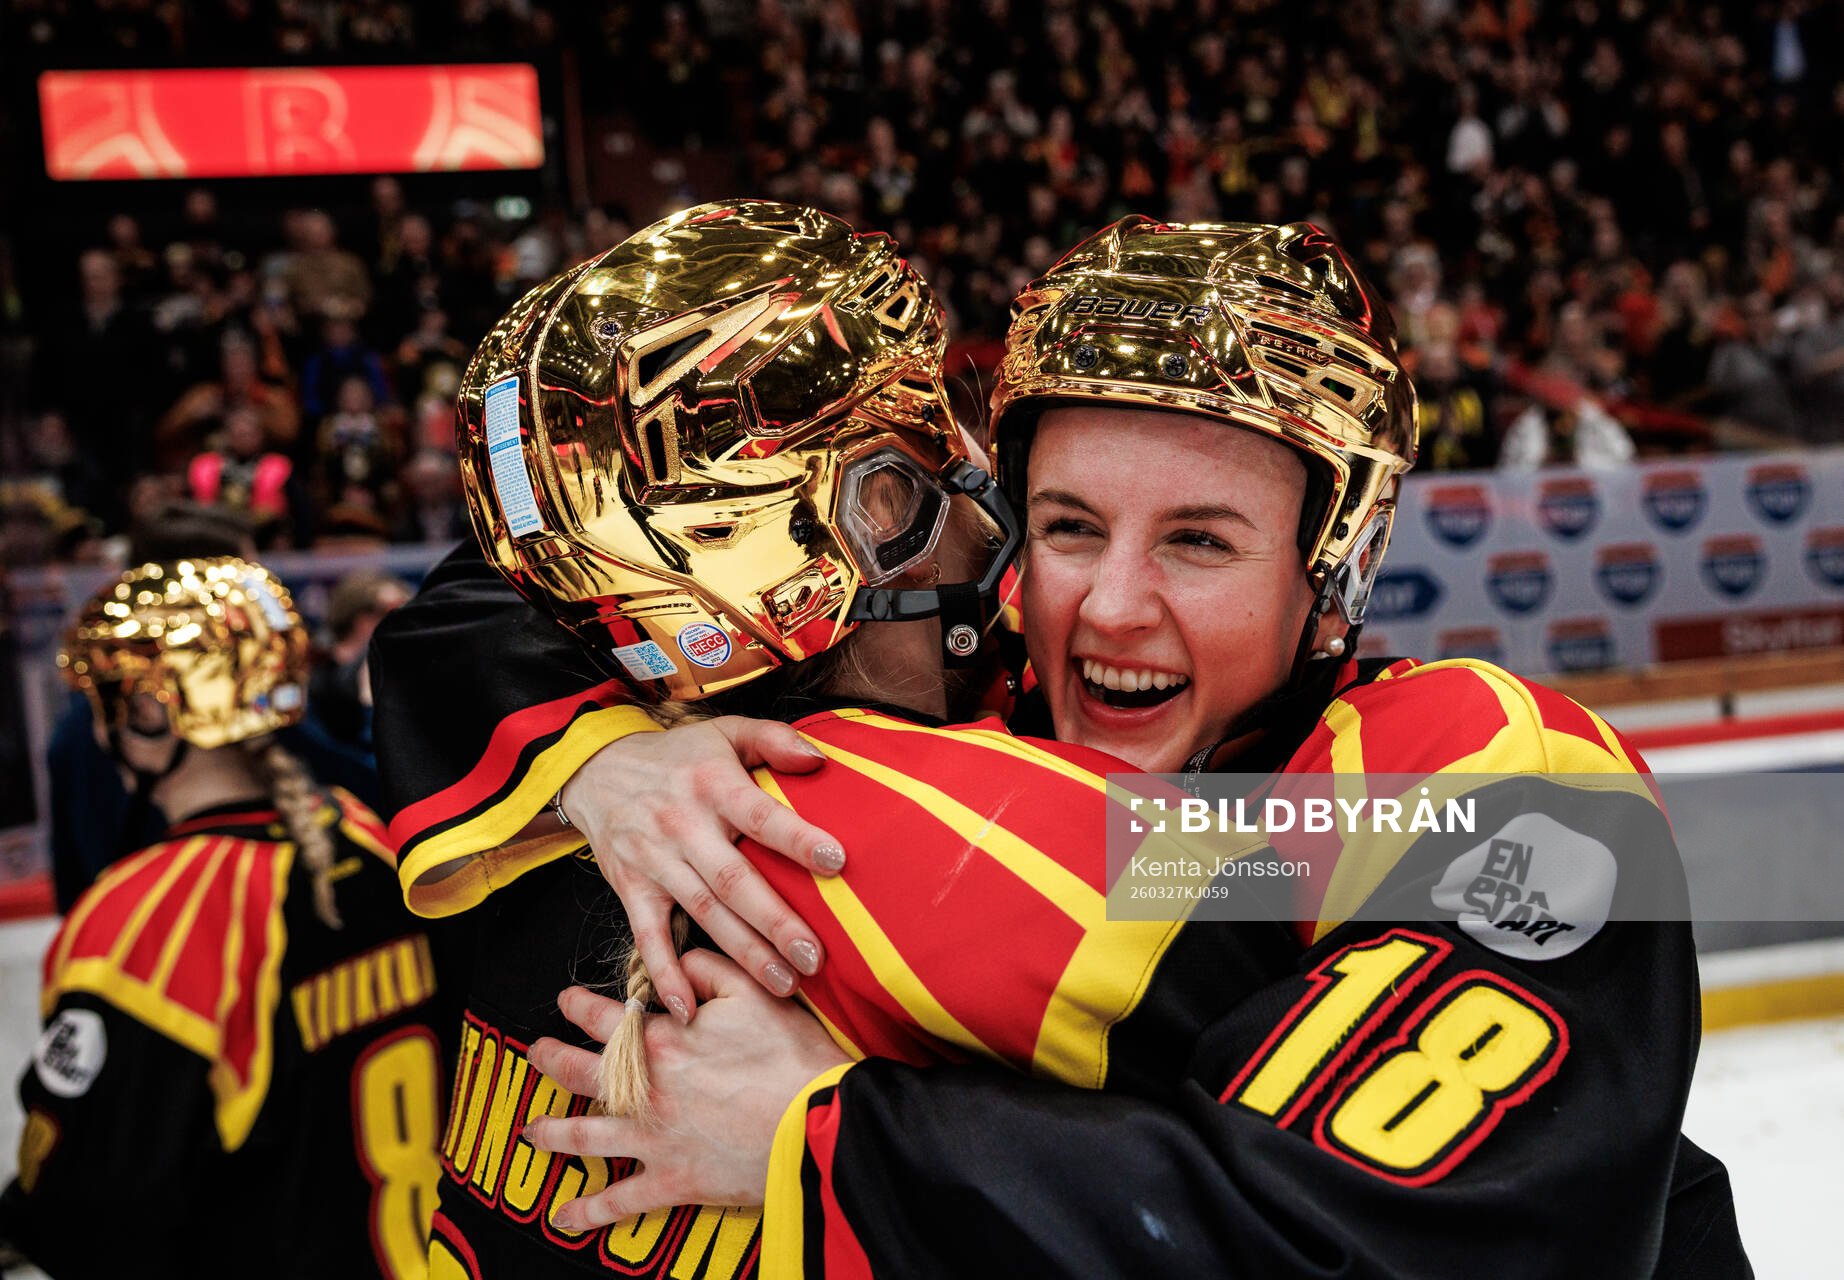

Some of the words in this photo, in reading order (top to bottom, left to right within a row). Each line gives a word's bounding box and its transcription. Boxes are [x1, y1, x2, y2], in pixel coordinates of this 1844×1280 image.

[1070, 296, 1210, 325] BAUER
[689, 634, 725, 656] HECC
[1479, 837, 1534, 886] EN
[1221, 930, 1568, 1186] 18
